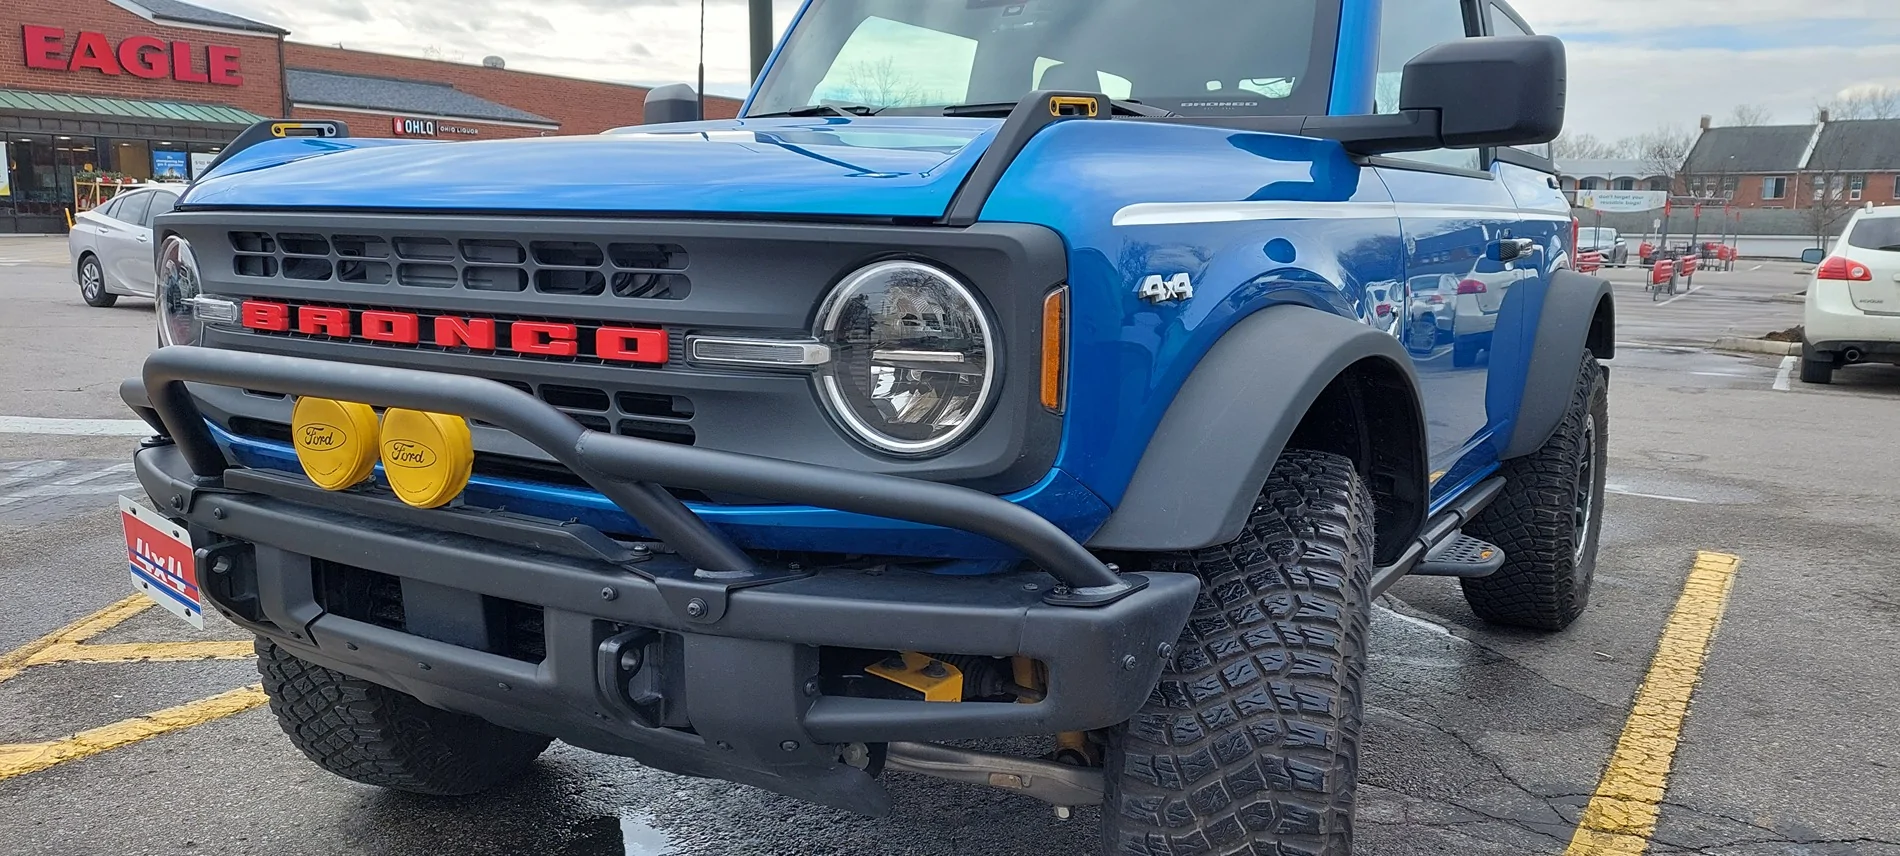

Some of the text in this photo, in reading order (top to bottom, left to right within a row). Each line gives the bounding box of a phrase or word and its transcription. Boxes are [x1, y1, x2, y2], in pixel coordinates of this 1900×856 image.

[22, 24, 243, 86] EAGLE
[405, 120, 433, 135] OHLQ
[439, 125, 456, 133] OHIO
[241, 299, 669, 364] BRONCO
[305, 426, 335, 447] Ford
[391, 442, 425, 464] Ford
